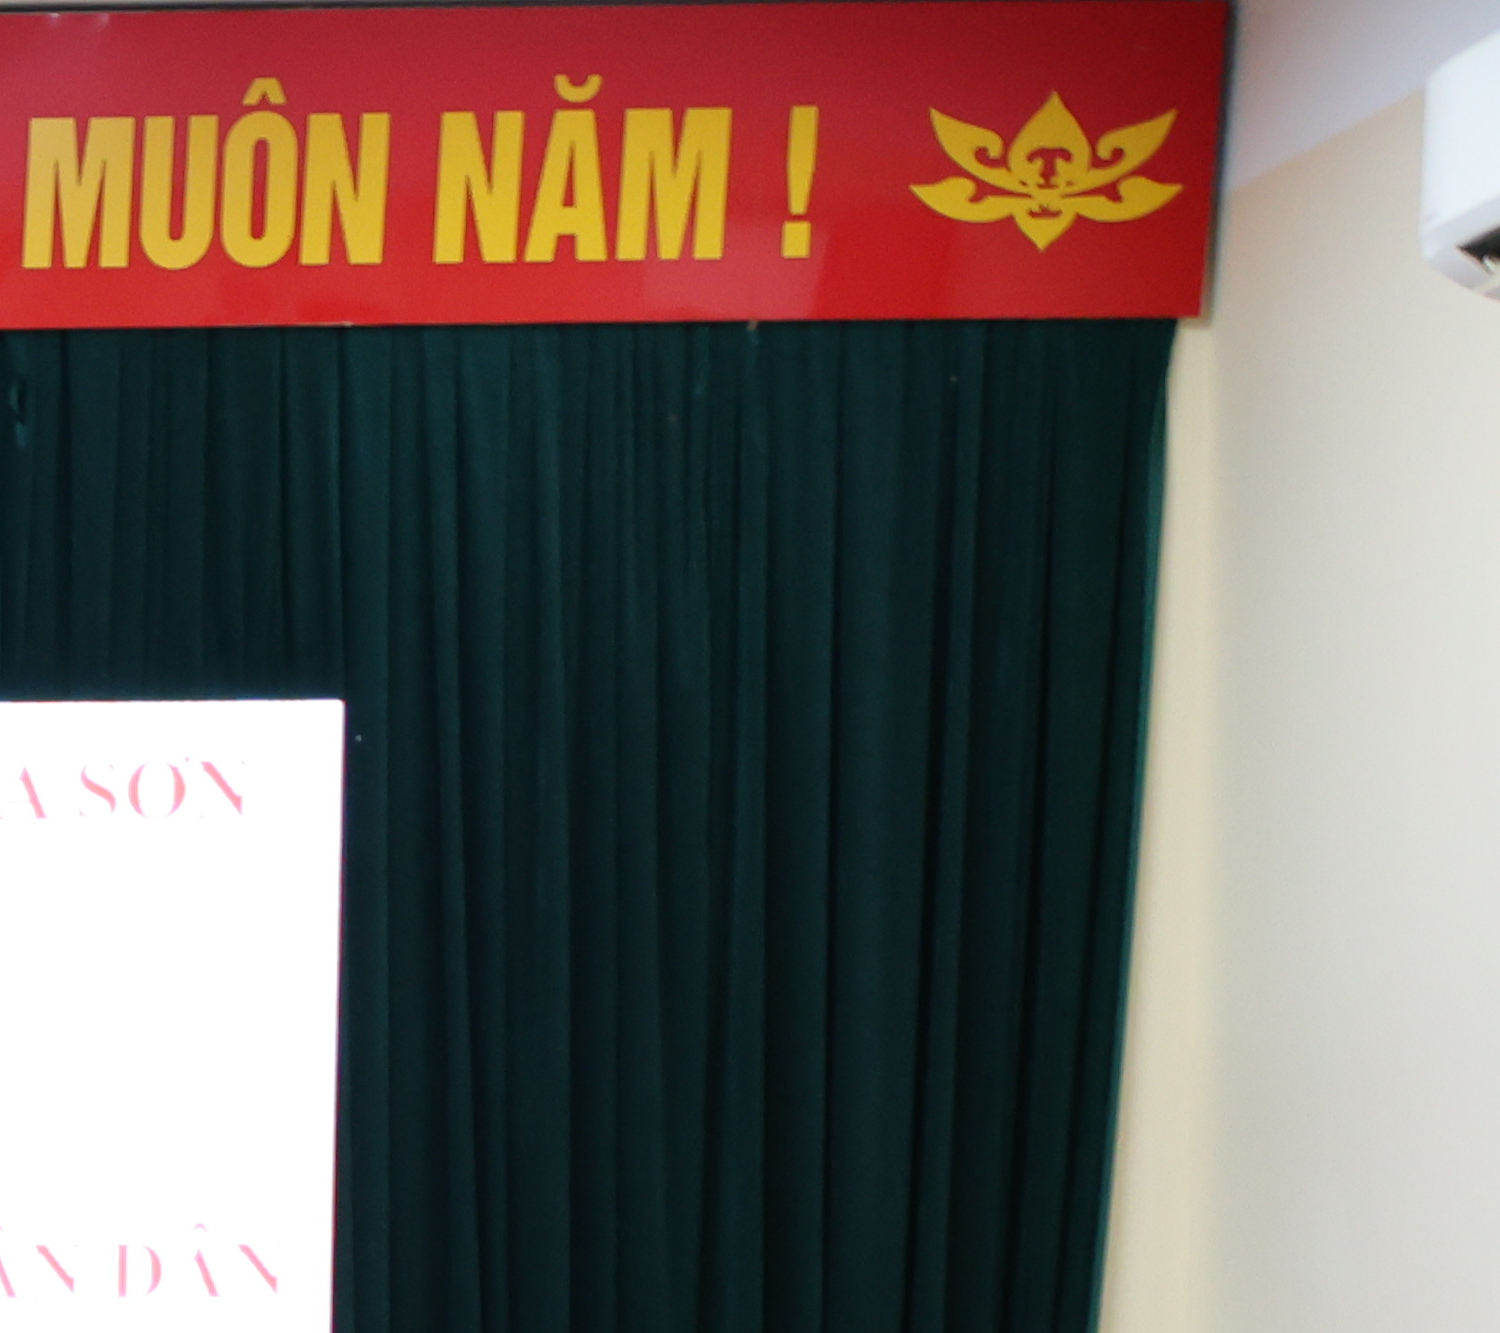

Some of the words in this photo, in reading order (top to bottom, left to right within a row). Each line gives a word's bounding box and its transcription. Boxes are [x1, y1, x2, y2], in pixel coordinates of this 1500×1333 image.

[22, 78, 390, 270] MUÔN
[433, 74, 732, 264] NĂM
[781, 106, 818, 258] !
